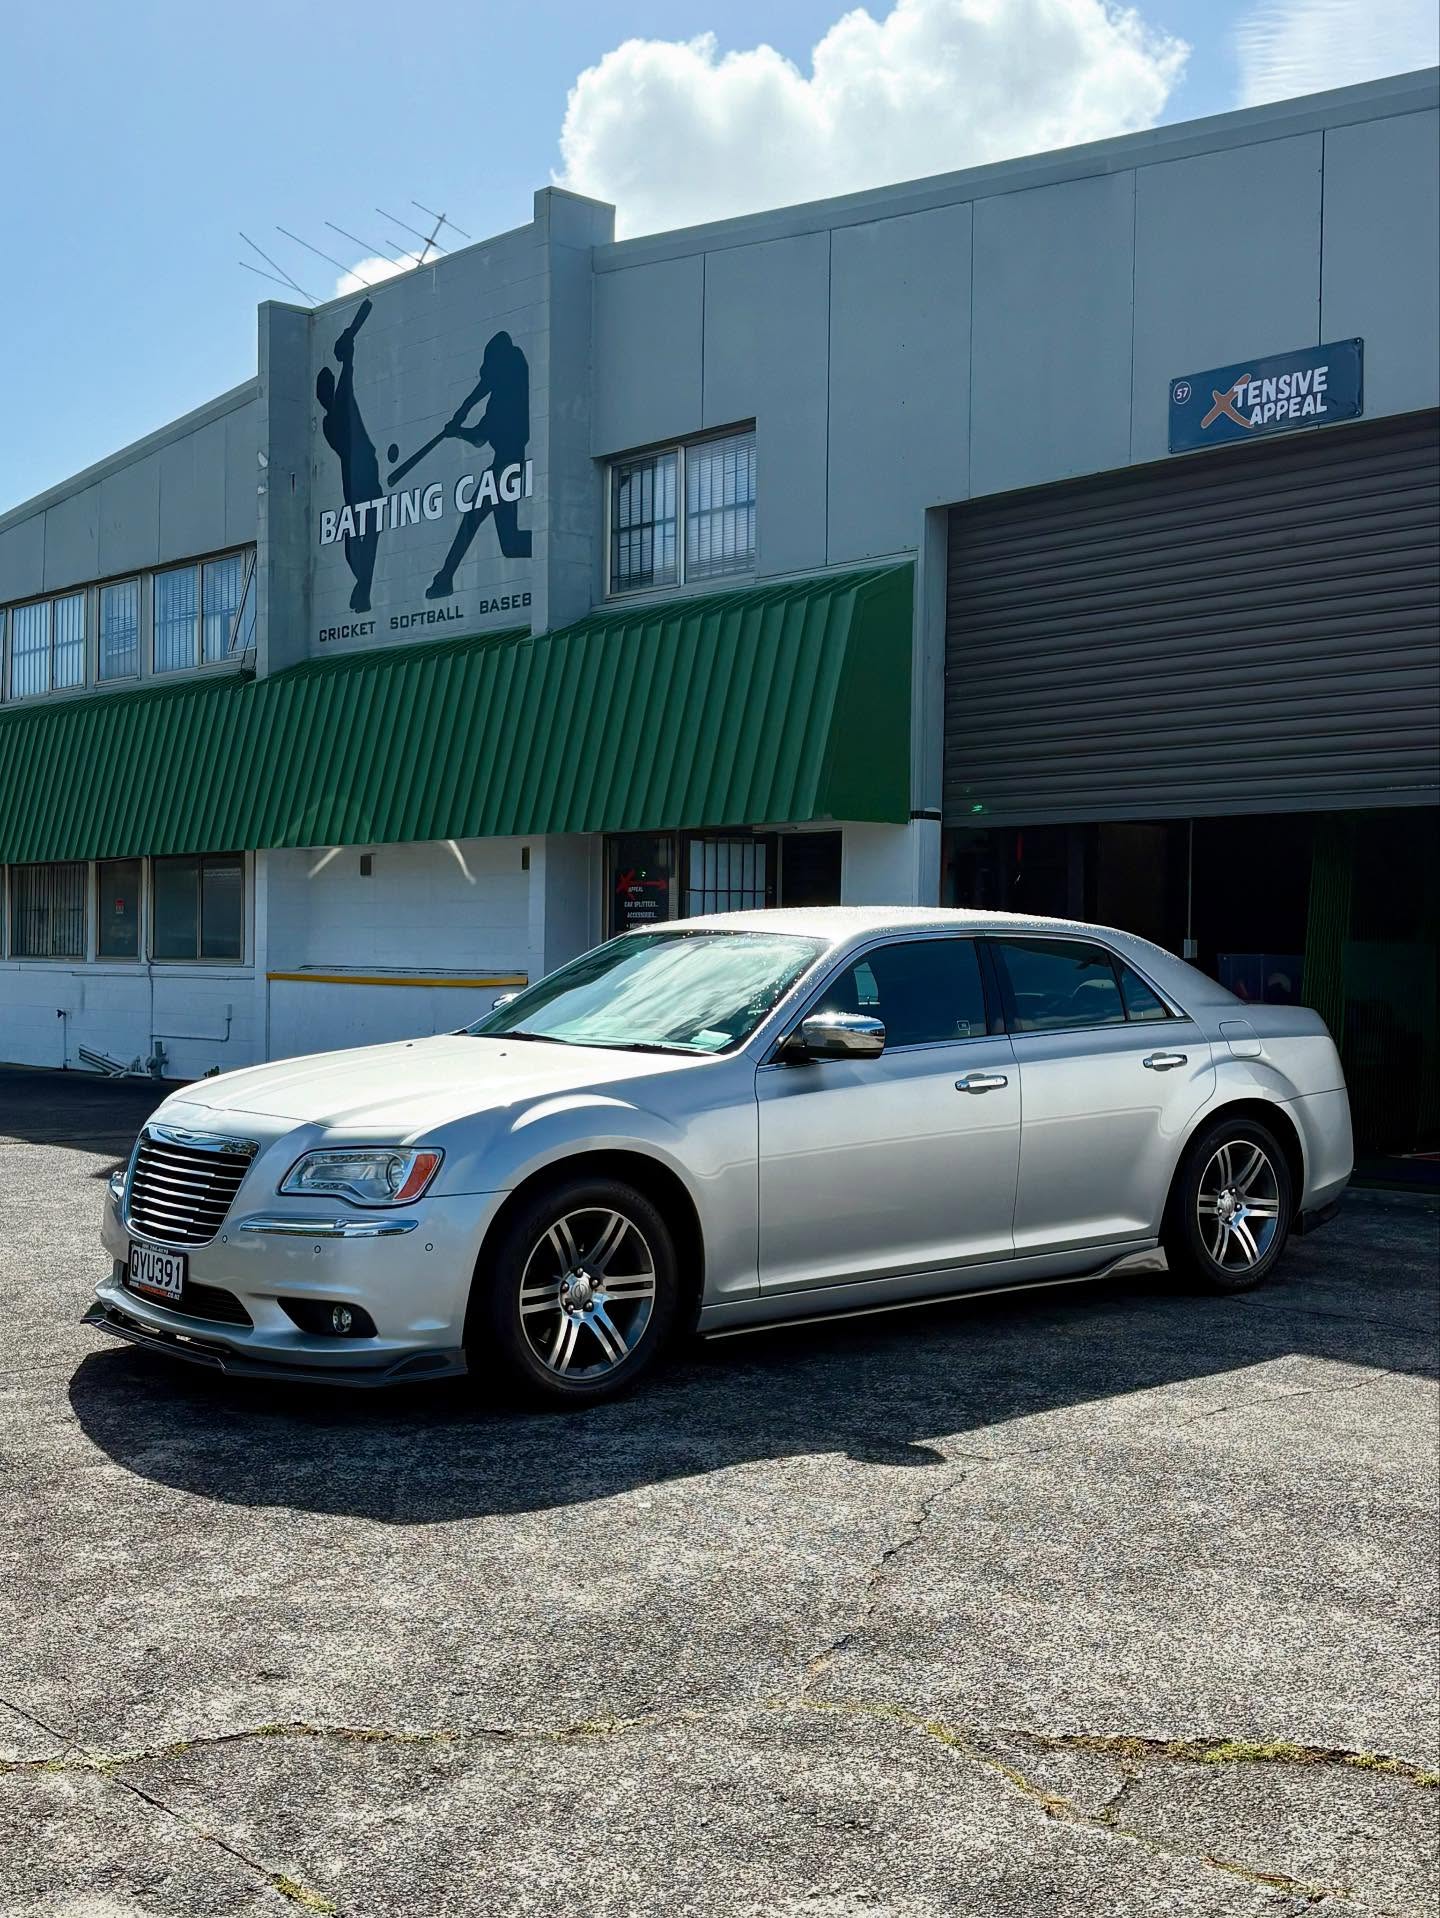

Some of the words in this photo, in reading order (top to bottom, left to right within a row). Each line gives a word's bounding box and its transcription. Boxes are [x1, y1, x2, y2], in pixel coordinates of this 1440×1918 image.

[1176, 387, 1189, 399] 57
[1249, 392, 1328, 426] APPEAL
[319, 482, 443, 545] BATTING
[319, 621, 377, 642] CRICKET
[389, 605, 464, 630] SOFTBALL
[131, 1249, 180, 1290] QYU391
